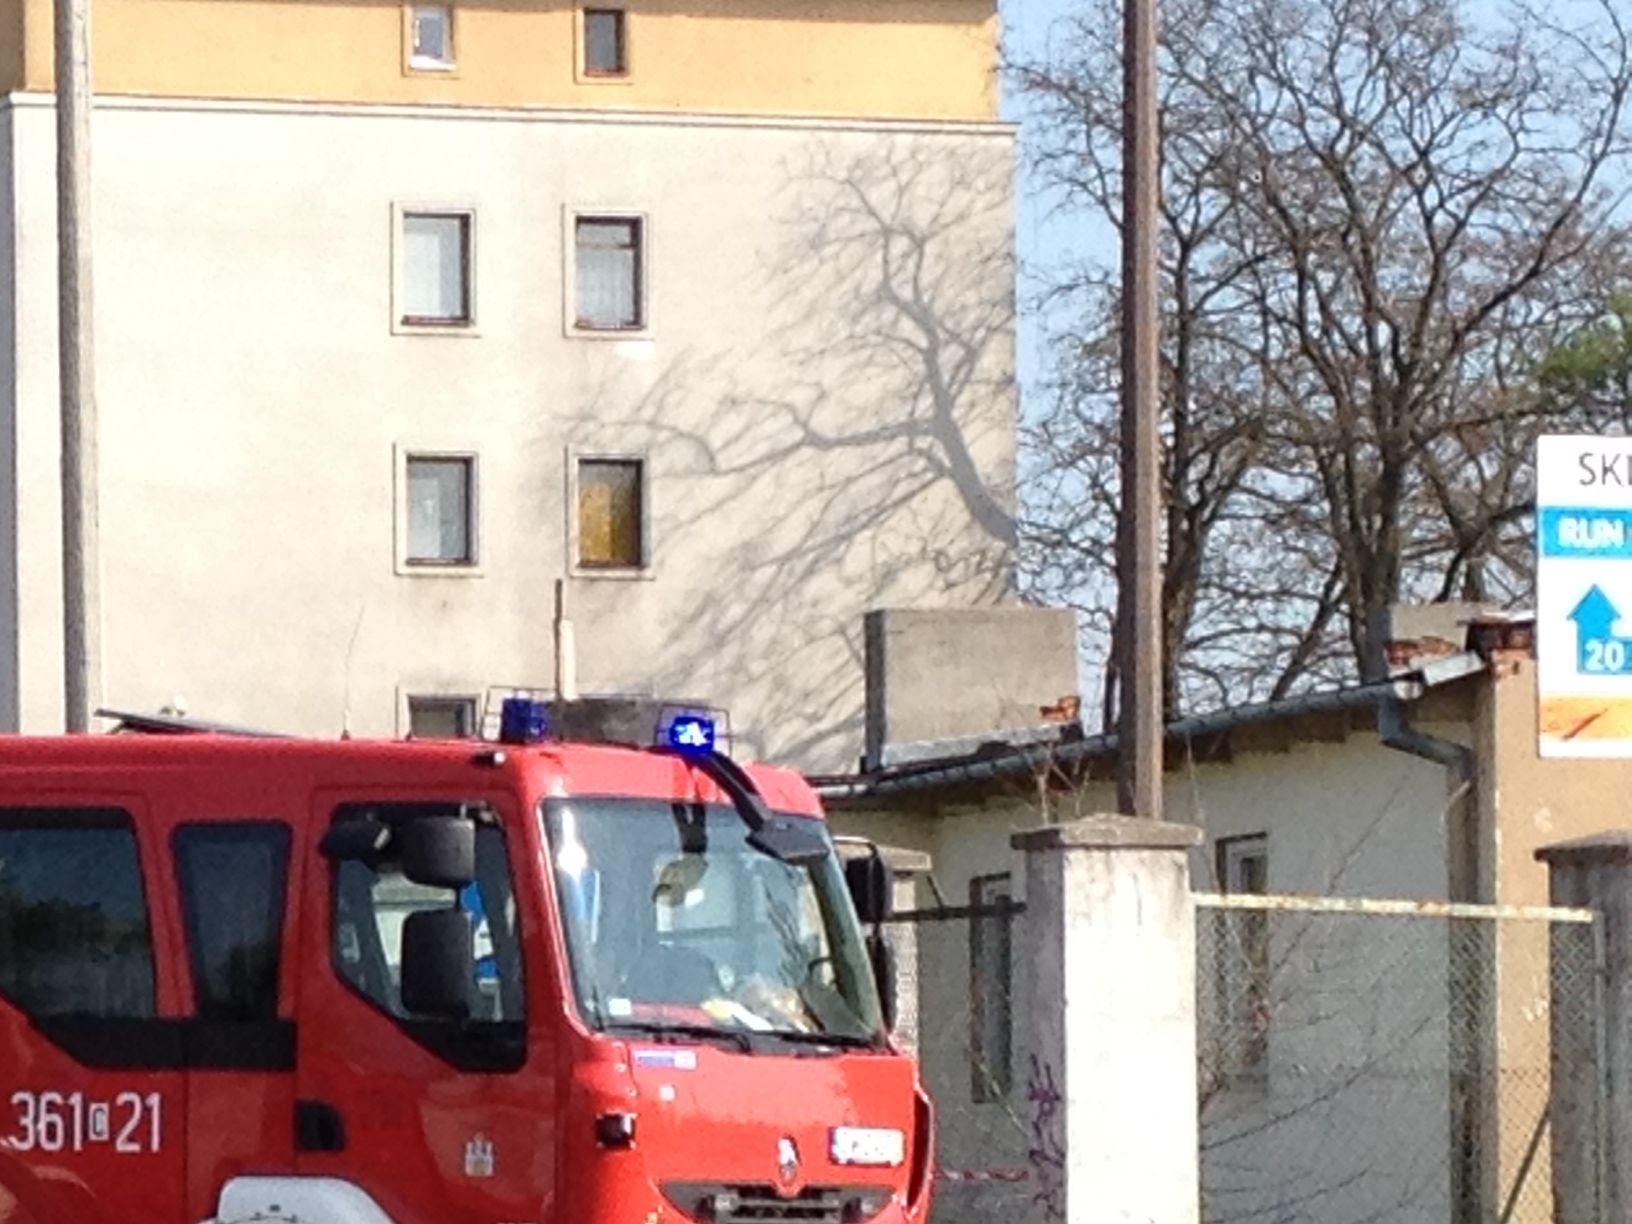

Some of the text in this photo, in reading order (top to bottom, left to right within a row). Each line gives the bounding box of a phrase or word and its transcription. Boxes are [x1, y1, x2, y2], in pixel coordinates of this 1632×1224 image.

[1579, 452, 1632, 487] SK
[1585, 639, 1625, 671] 20
[10, 1091, 83, 1152] 361
[114, 1091, 162, 1152] 21
